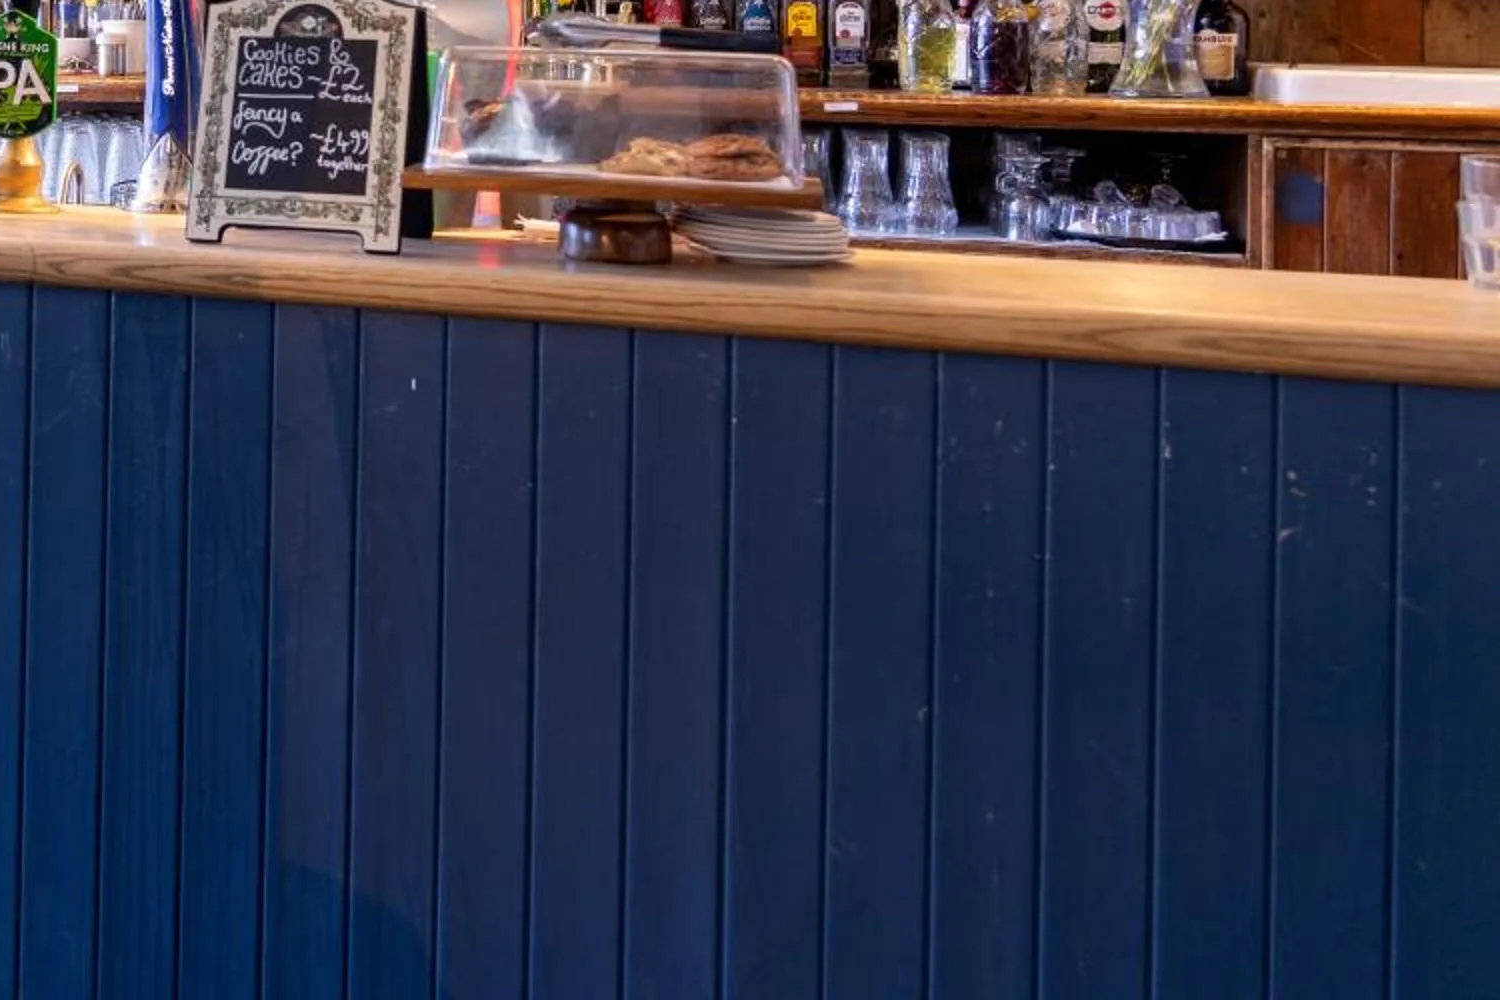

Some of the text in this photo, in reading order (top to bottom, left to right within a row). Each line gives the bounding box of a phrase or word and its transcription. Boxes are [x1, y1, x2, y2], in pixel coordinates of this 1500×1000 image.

[20, 42, 50, 53] KING
[243, 39, 353, 68] Cookies &
[238, 63, 304, 89] Cakes
[341, 91, 373, 105] each
[290, 110, 304, 124] a
[316, 155, 369, 181] together
